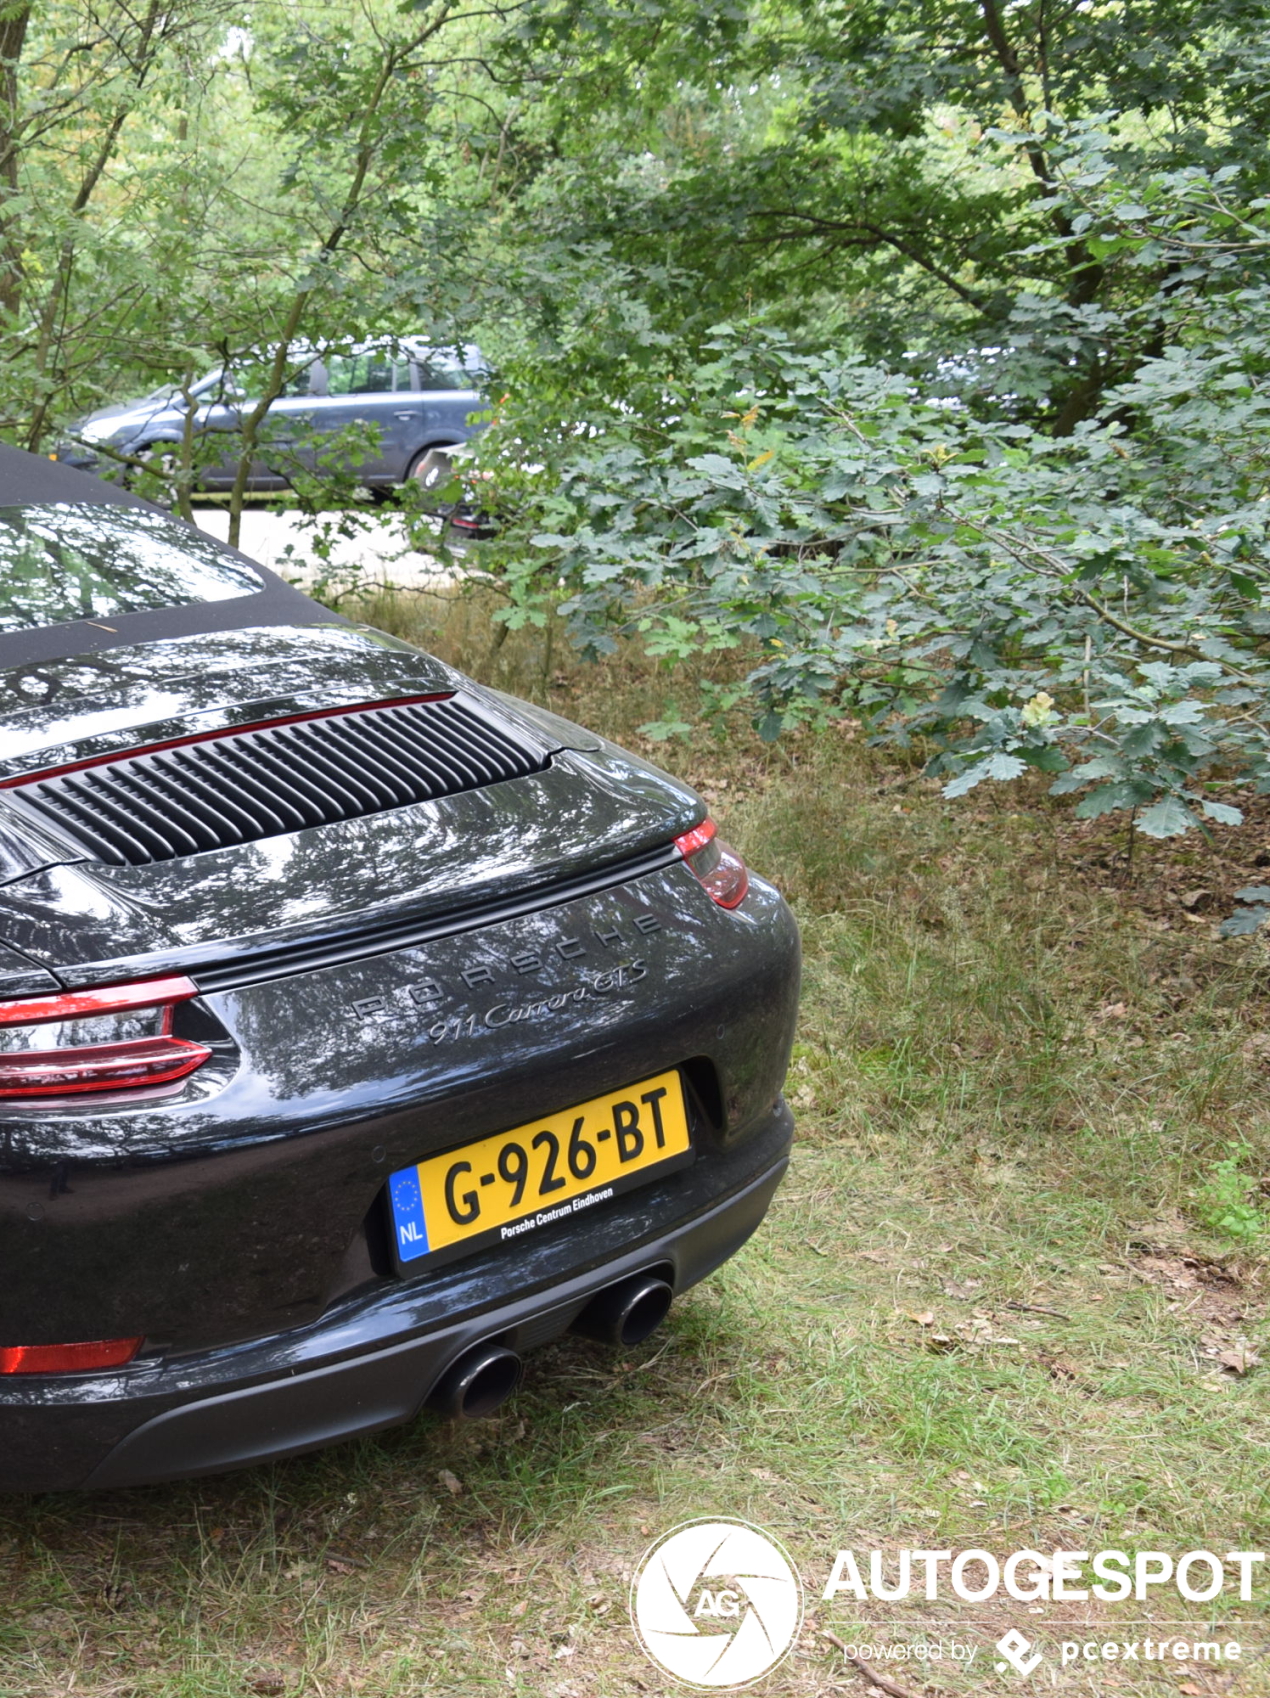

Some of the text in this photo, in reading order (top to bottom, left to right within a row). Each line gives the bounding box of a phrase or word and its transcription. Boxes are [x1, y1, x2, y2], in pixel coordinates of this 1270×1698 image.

[352, 913, 662, 1020] PORSCHE
[429, 959, 649, 1046] 911 Carrera GTS
[444, 1087, 668, 1226] G-926-BT
[399, 1222, 423, 1245] NL
[500, 1187, 614, 1239] Porsche Centrum Eindhoven
